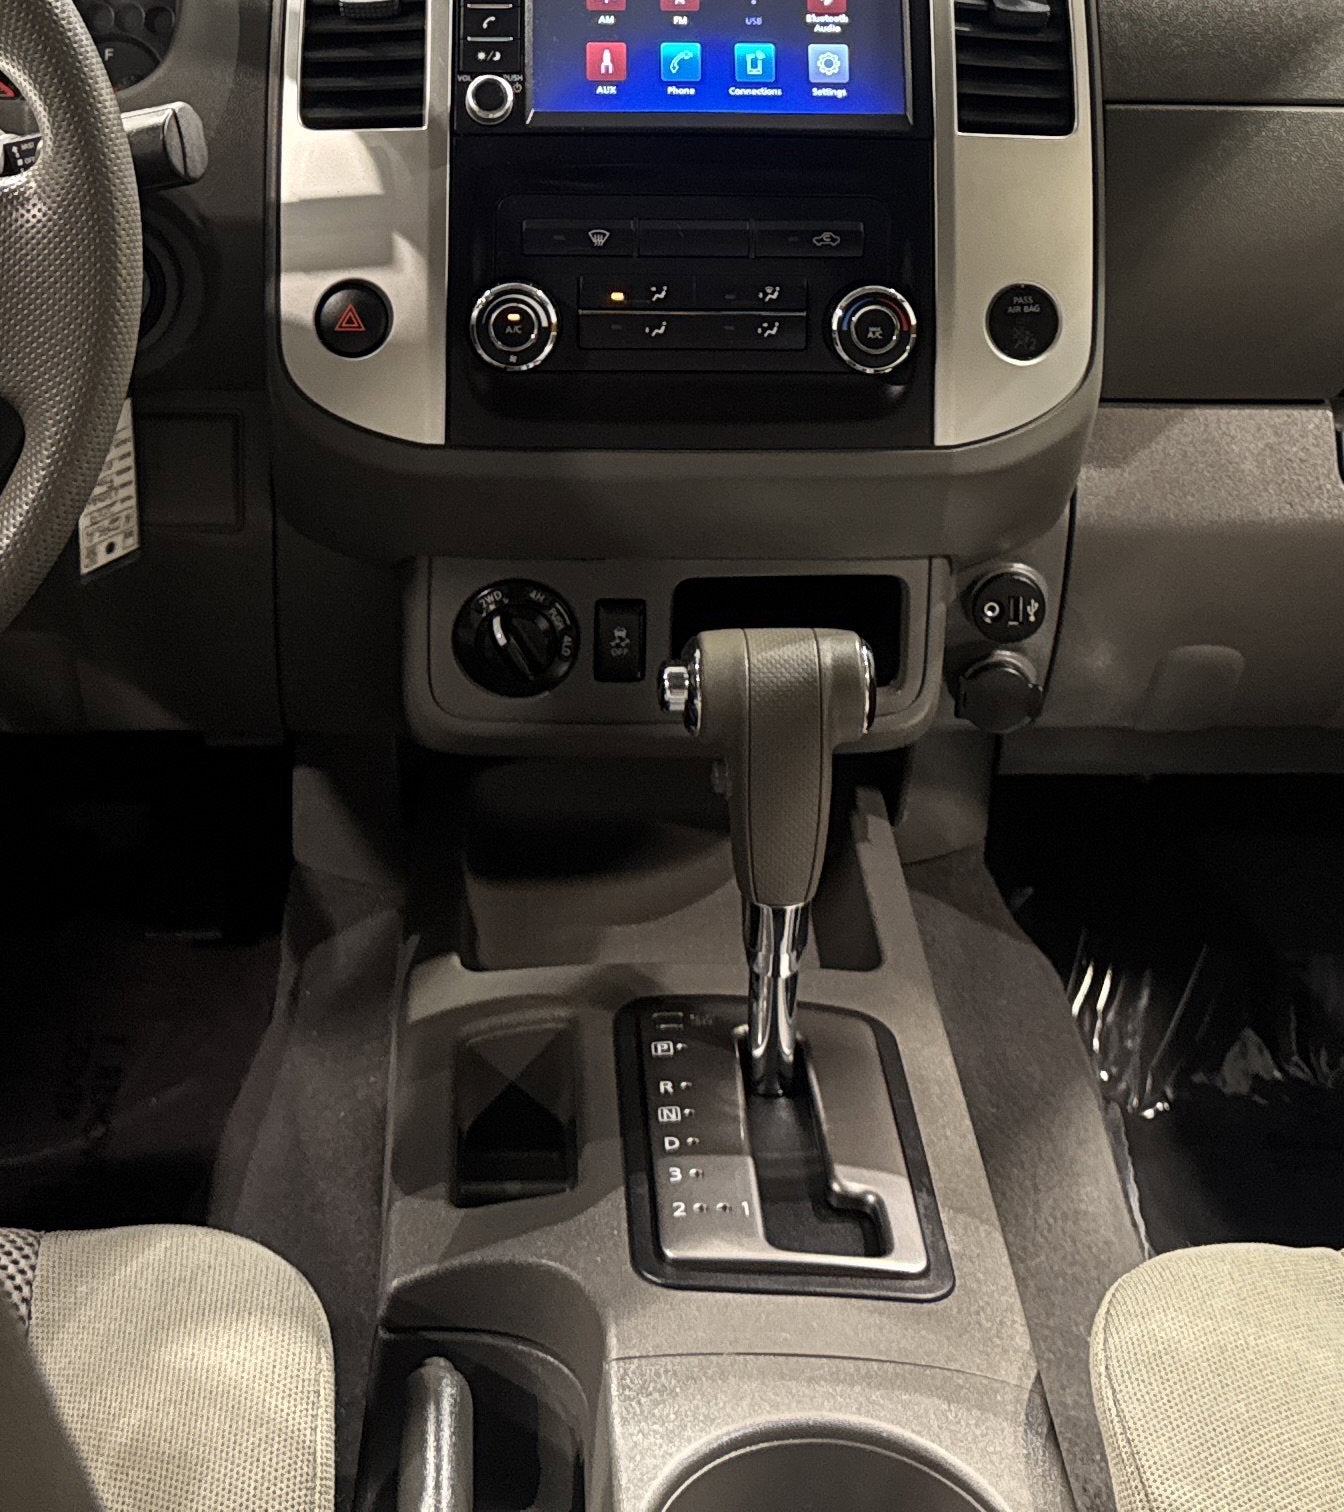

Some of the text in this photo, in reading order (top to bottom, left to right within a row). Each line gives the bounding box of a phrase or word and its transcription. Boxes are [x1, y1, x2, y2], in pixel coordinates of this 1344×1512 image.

[597, 15, 616, 25] AM
[672, 15, 689, 25] FM
[745, 17, 763, 26] USB
[813, 24, 842, 33] Audio
[104, 48, 114, 61] F
[596, 86, 618, 95] AUX
[667, 86, 696, 96] Phone
[728, 87, 783, 96] Connections
[812, 88, 848, 99] Settings
[1013, 296, 1034, 304] PASS
[478, 590, 504, 609] 2WD
[659, 1081, 674, 1094] R
[663, 1108, 677, 1121] N
[664, 1136, 680, 1151] D
[668, 1167, 683, 1183] 3
[672, 1201, 750, 1217] 2 1
